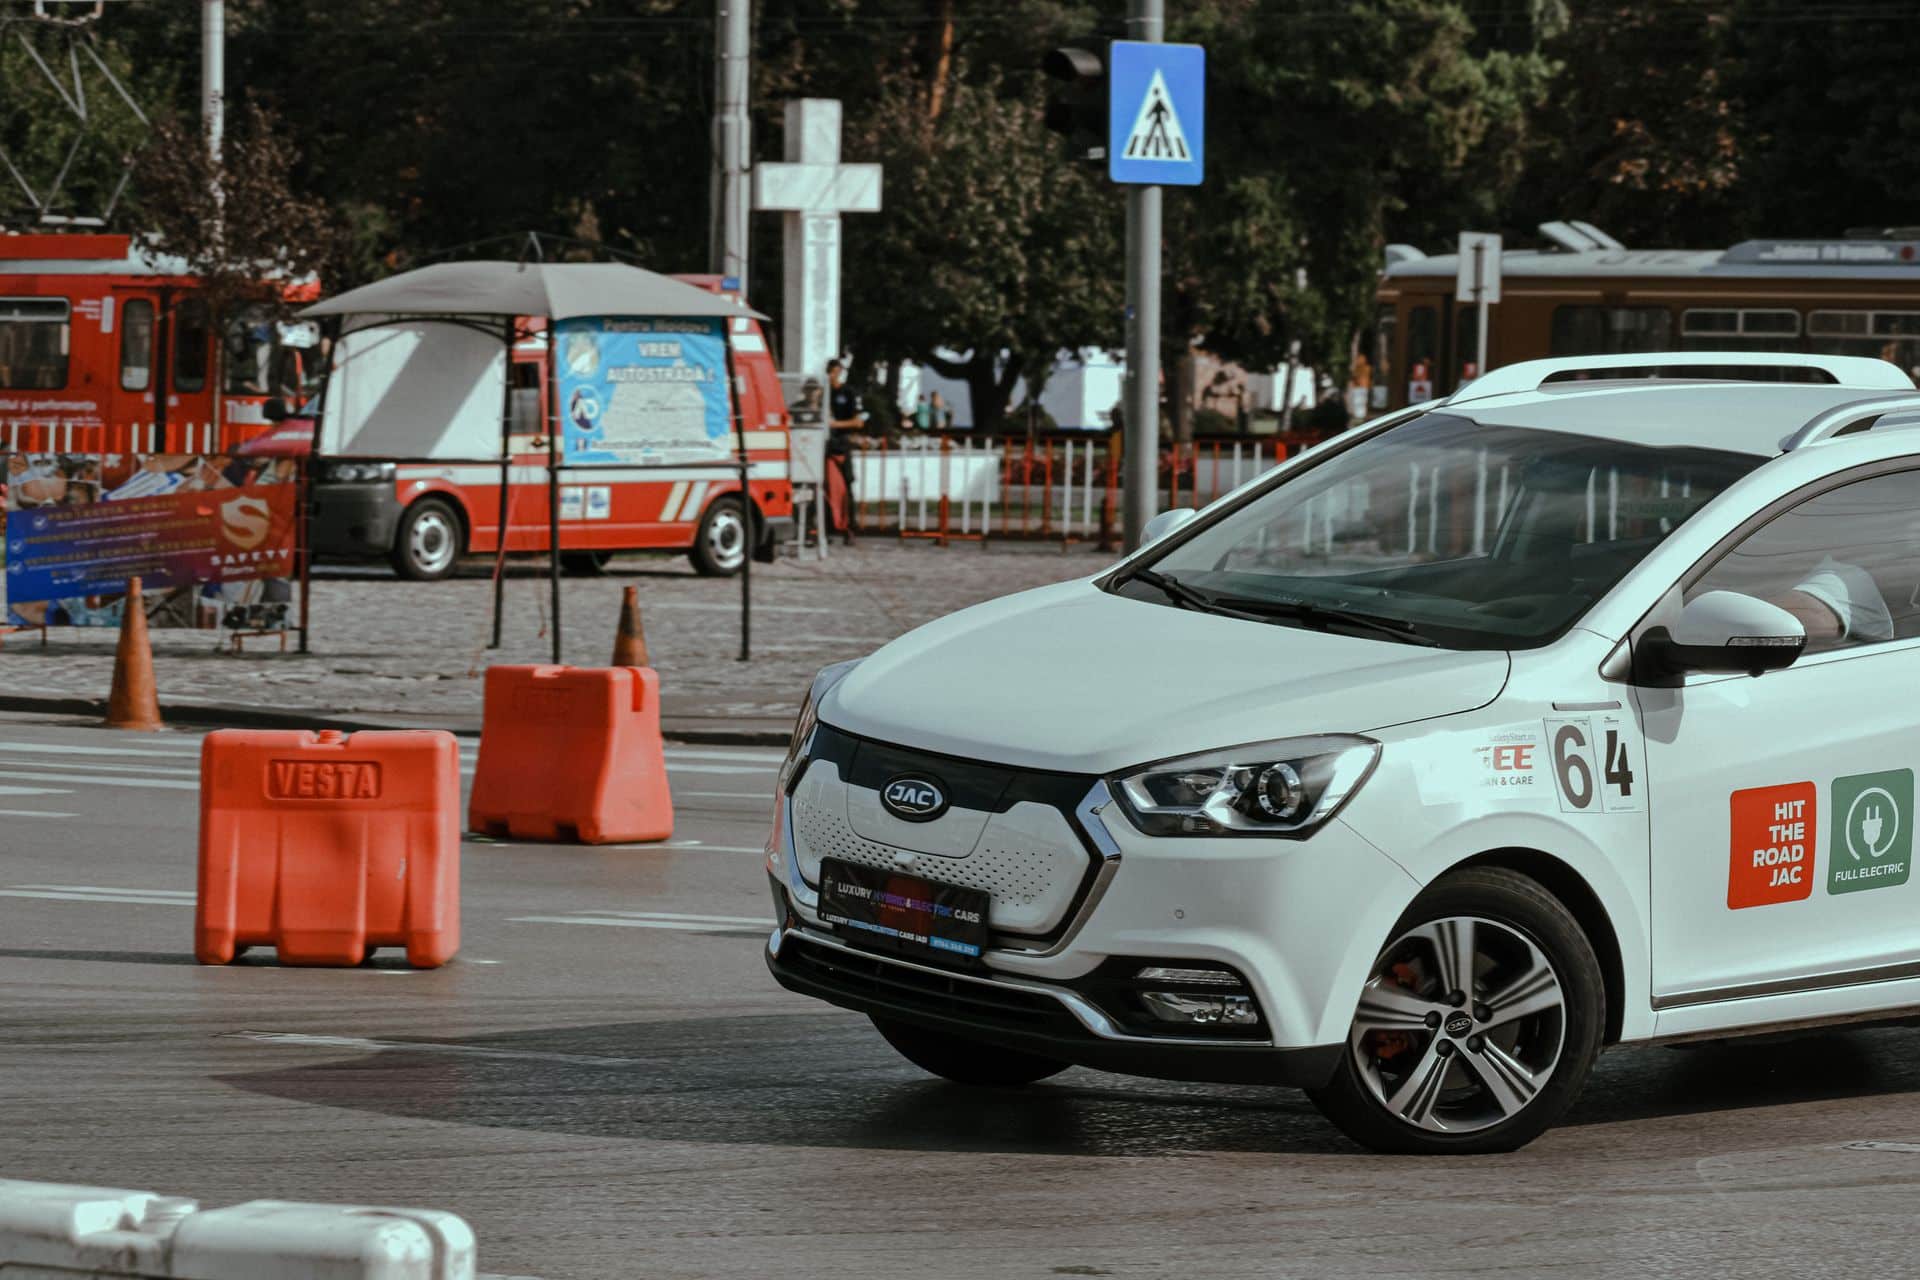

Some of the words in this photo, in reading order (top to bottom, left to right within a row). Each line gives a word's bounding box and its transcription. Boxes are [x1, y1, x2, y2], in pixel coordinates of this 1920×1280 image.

[638, 342, 681, 357] VREM
[210, 549, 289, 566] SAFETY
[274, 762, 378, 798] VESTA
[1500, 776, 1507, 786] &
[1509, 775, 1534, 786] CARE
[890, 785, 933, 806] JAC
[1774, 800, 1806, 821] HIT
[1769, 822, 1805, 844] THE
[1753, 844, 1804, 868] ROAD
[1769, 866, 1803, 887] JAC
[1835, 870, 1858, 882] FULL
[1859, 862, 1905, 878] ELECTRIC
[837, 881, 872, 899] LUXURY
[954, 909, 980, 923] CARS
